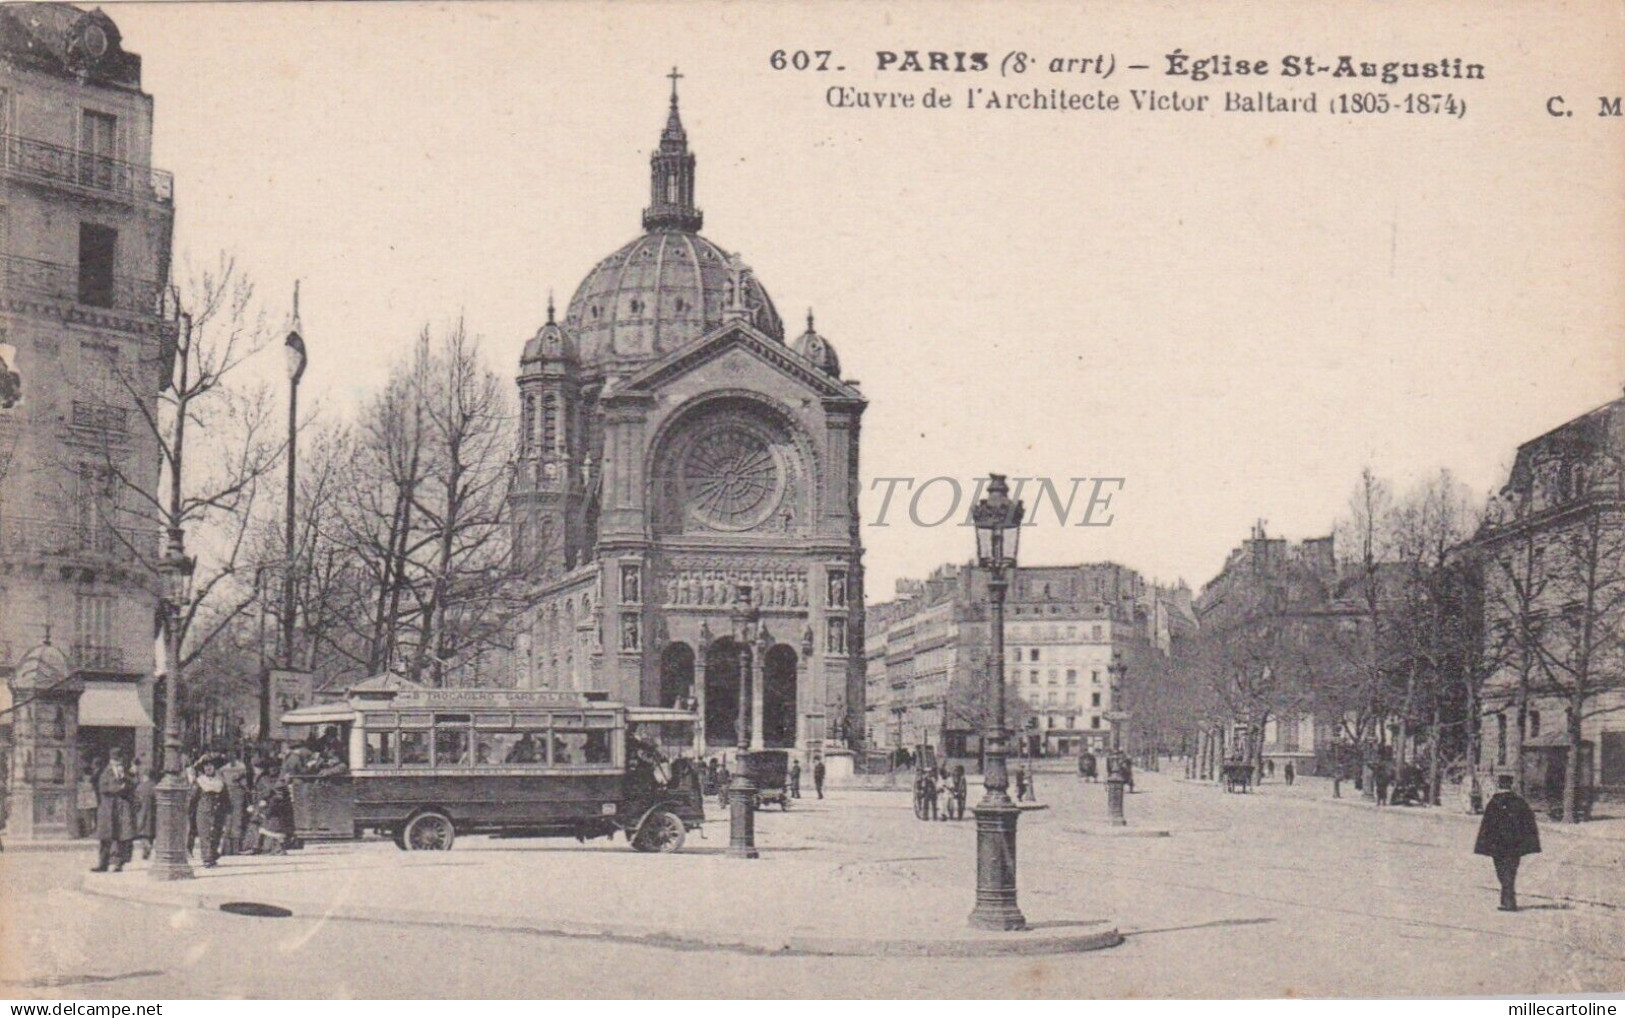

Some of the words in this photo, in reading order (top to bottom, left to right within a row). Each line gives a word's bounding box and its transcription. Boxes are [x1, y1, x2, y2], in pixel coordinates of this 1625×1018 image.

[769, 50, 846, 72] 607.
[876, 51, 989, 73] PARIS
[1048, 55, 1116, 81] arrt)
[1164, 48, 1269, 82] Église
[1280, 55, 1485, 84] St-Augustin
[826, 87, 915, 109] Œuvre
[922, 87, 952, 110] de
[967, 88, 1119, 112] l'Architecte
[1129, 90, 1209, 113] Victor
[1225, 91, 1317, 114] Baltard
[1329, 92, 1467, 119] (1805-1874)
[1546, 96, 1574, 119] C.
